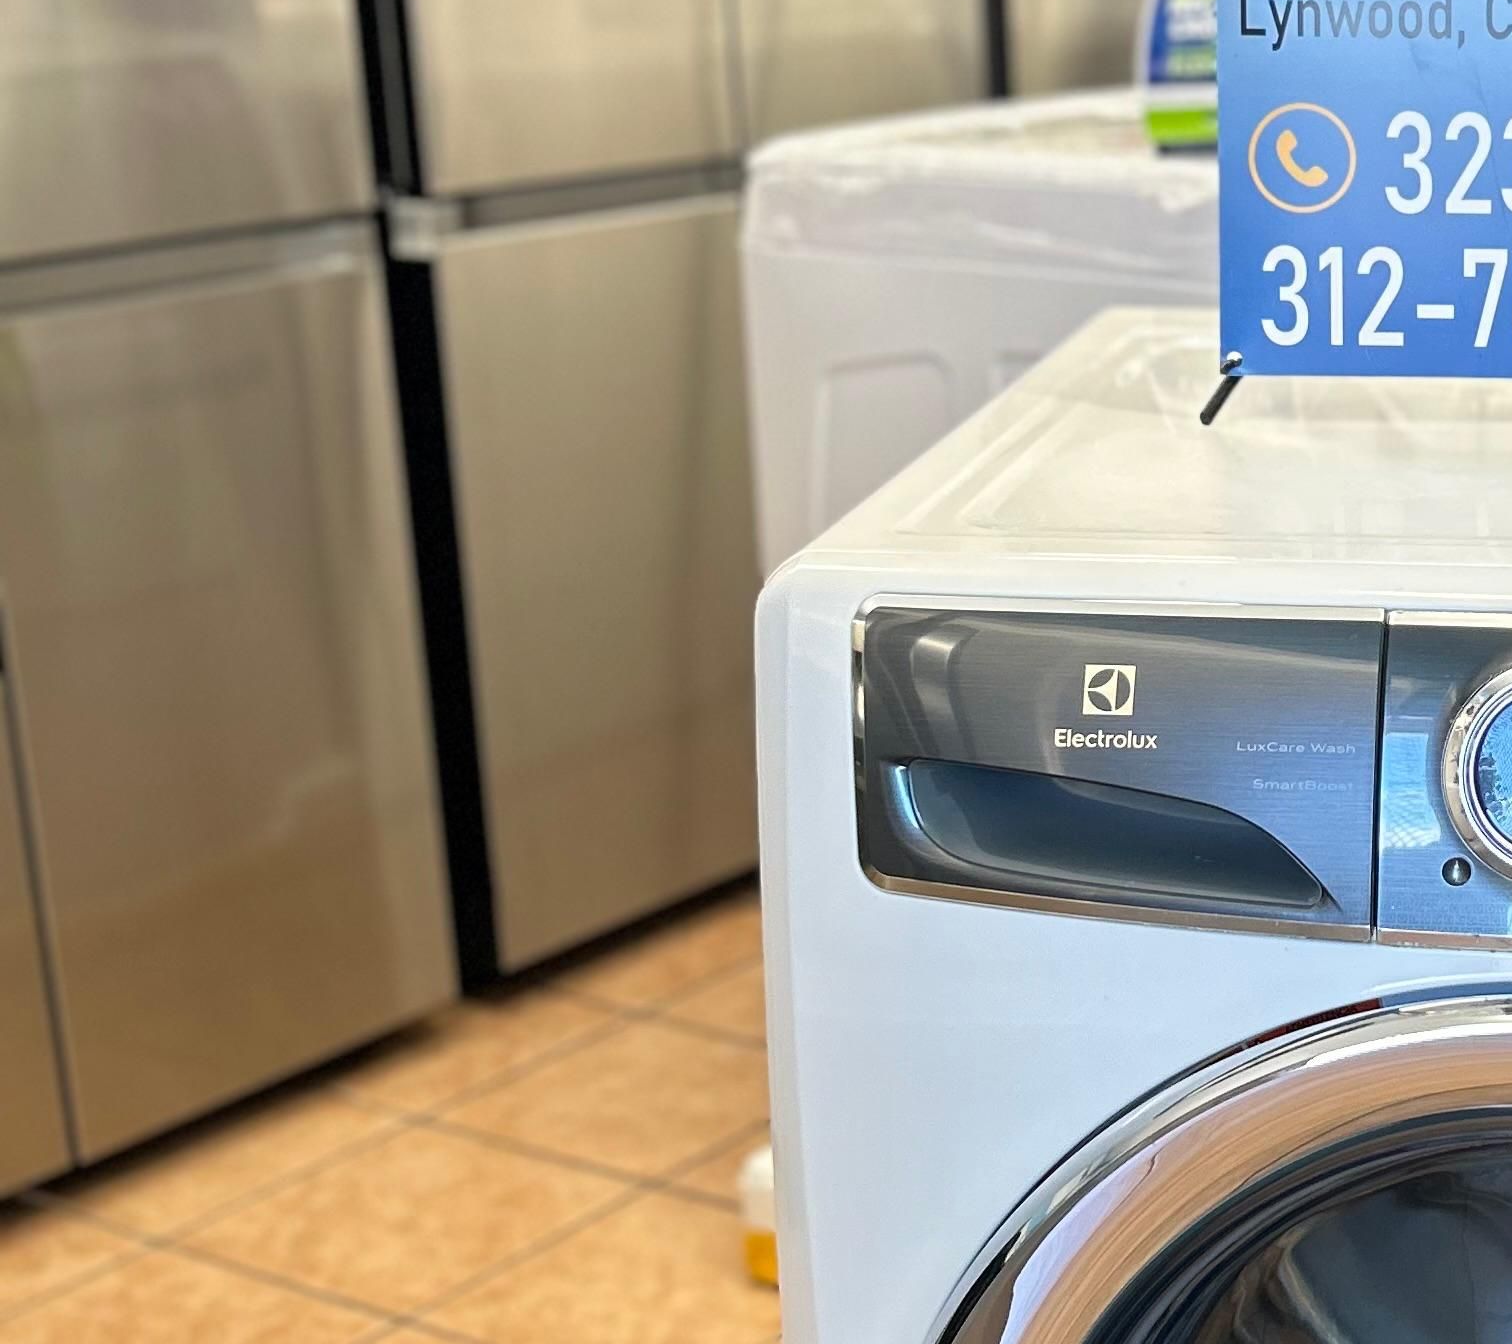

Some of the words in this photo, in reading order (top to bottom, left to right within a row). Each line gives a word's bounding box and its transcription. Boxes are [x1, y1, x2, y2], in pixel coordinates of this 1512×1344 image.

[1054, 728, 1158, 749] Electrolux
[1236, 741, 1305, 754] LuxCare
[1309, 743, 1356, 755] Wash
[1252, 778, 1354, 793] SmartBoost
